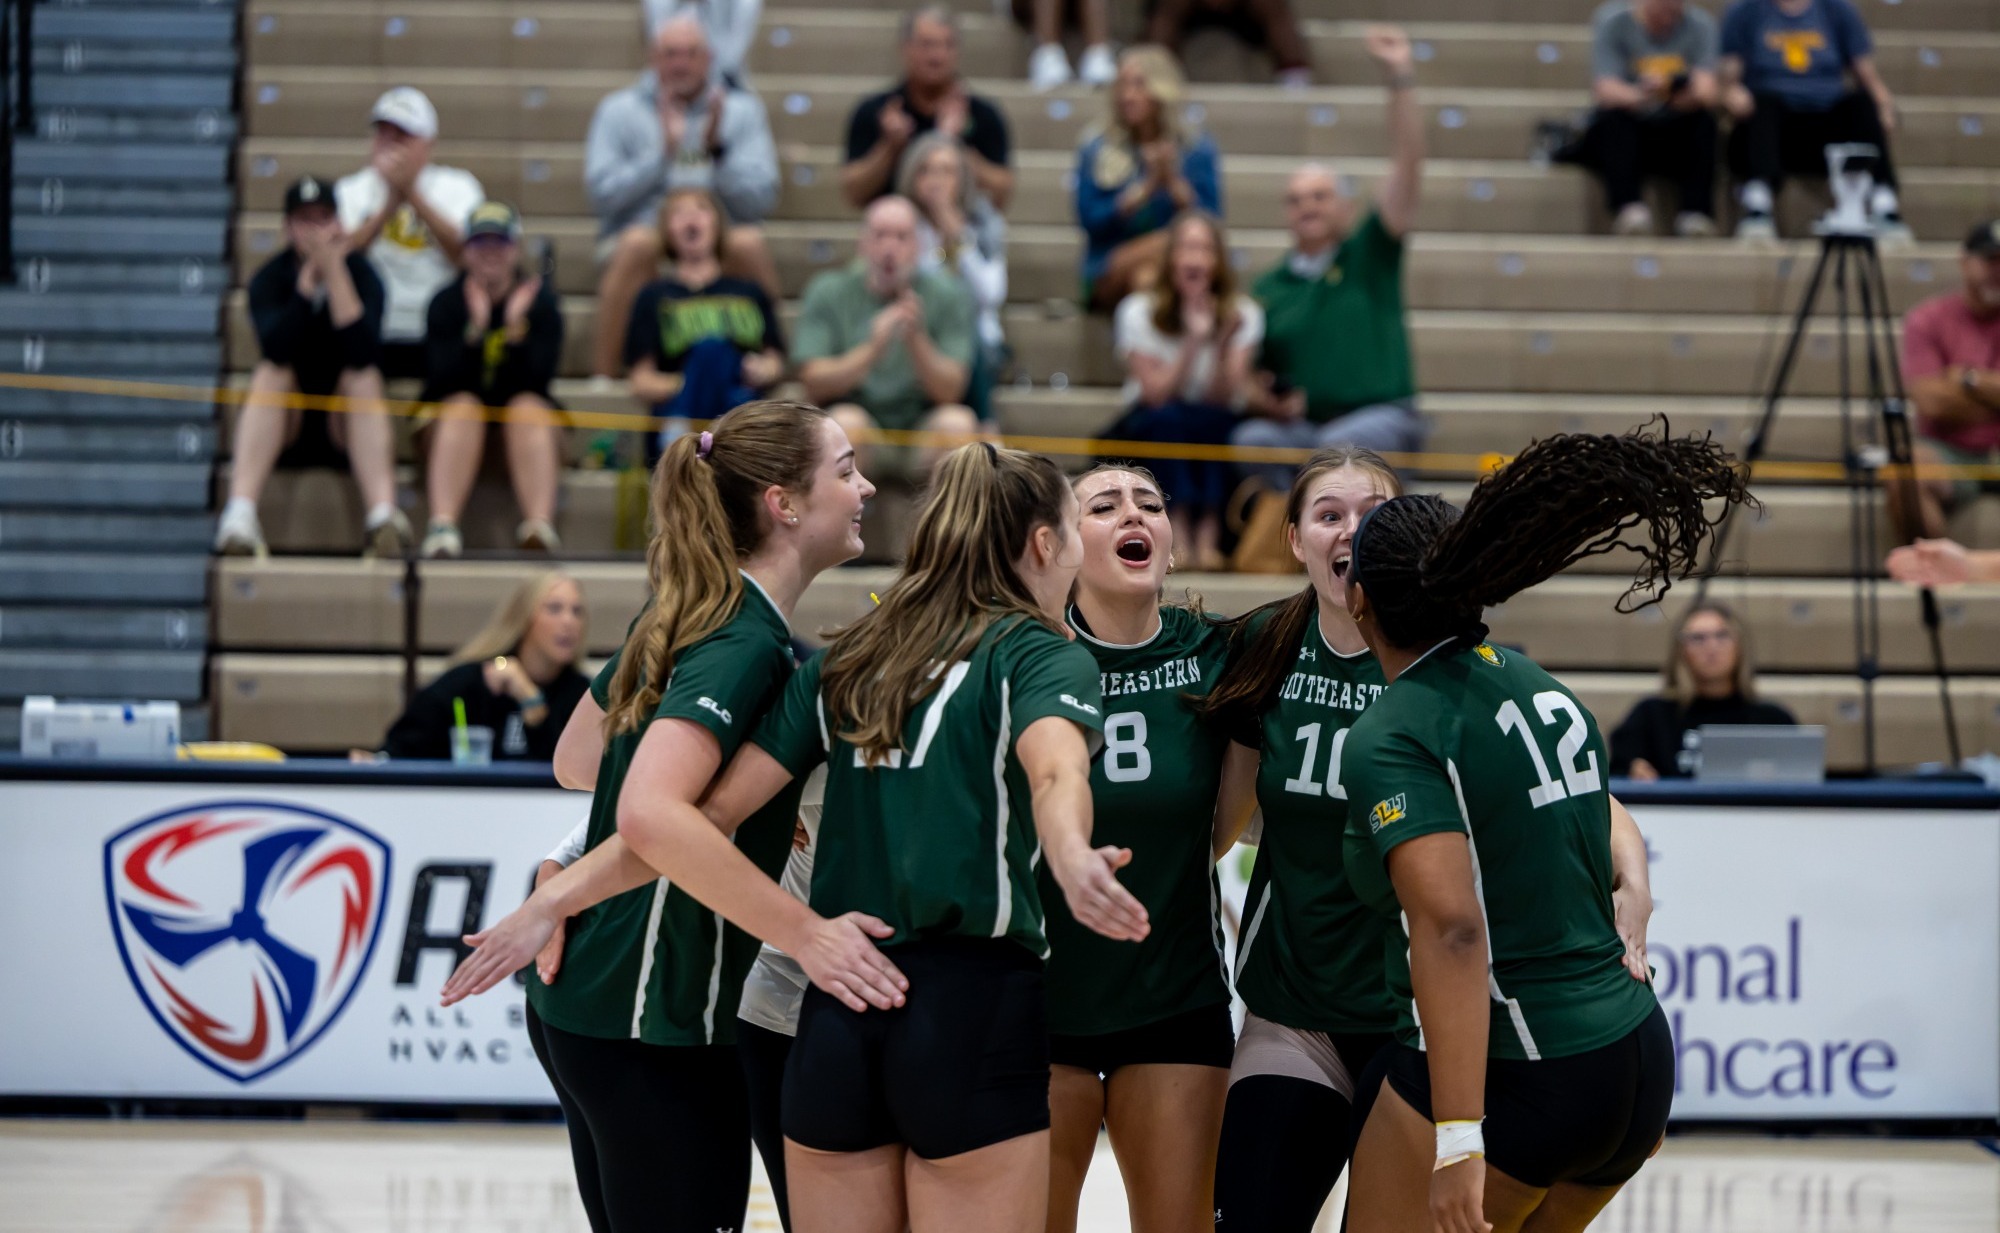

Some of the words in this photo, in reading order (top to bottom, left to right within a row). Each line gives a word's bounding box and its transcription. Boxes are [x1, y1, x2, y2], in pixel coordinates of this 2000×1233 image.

[853, 658, 972, 770] 7
[1278, 672, 1389, 711] OUTHEAST
[1104, 711, 1152, 782] 8
[1494, 690, 1602, 809] 12
[1369, 792, 1407, 834] SLU
[395, 861, 541, 987] A
[389, 1037, 512, 1064] HVAC
[391, 1003, 471, 1029] ALL
[1672, 1010, 1899, 1100] hcare
